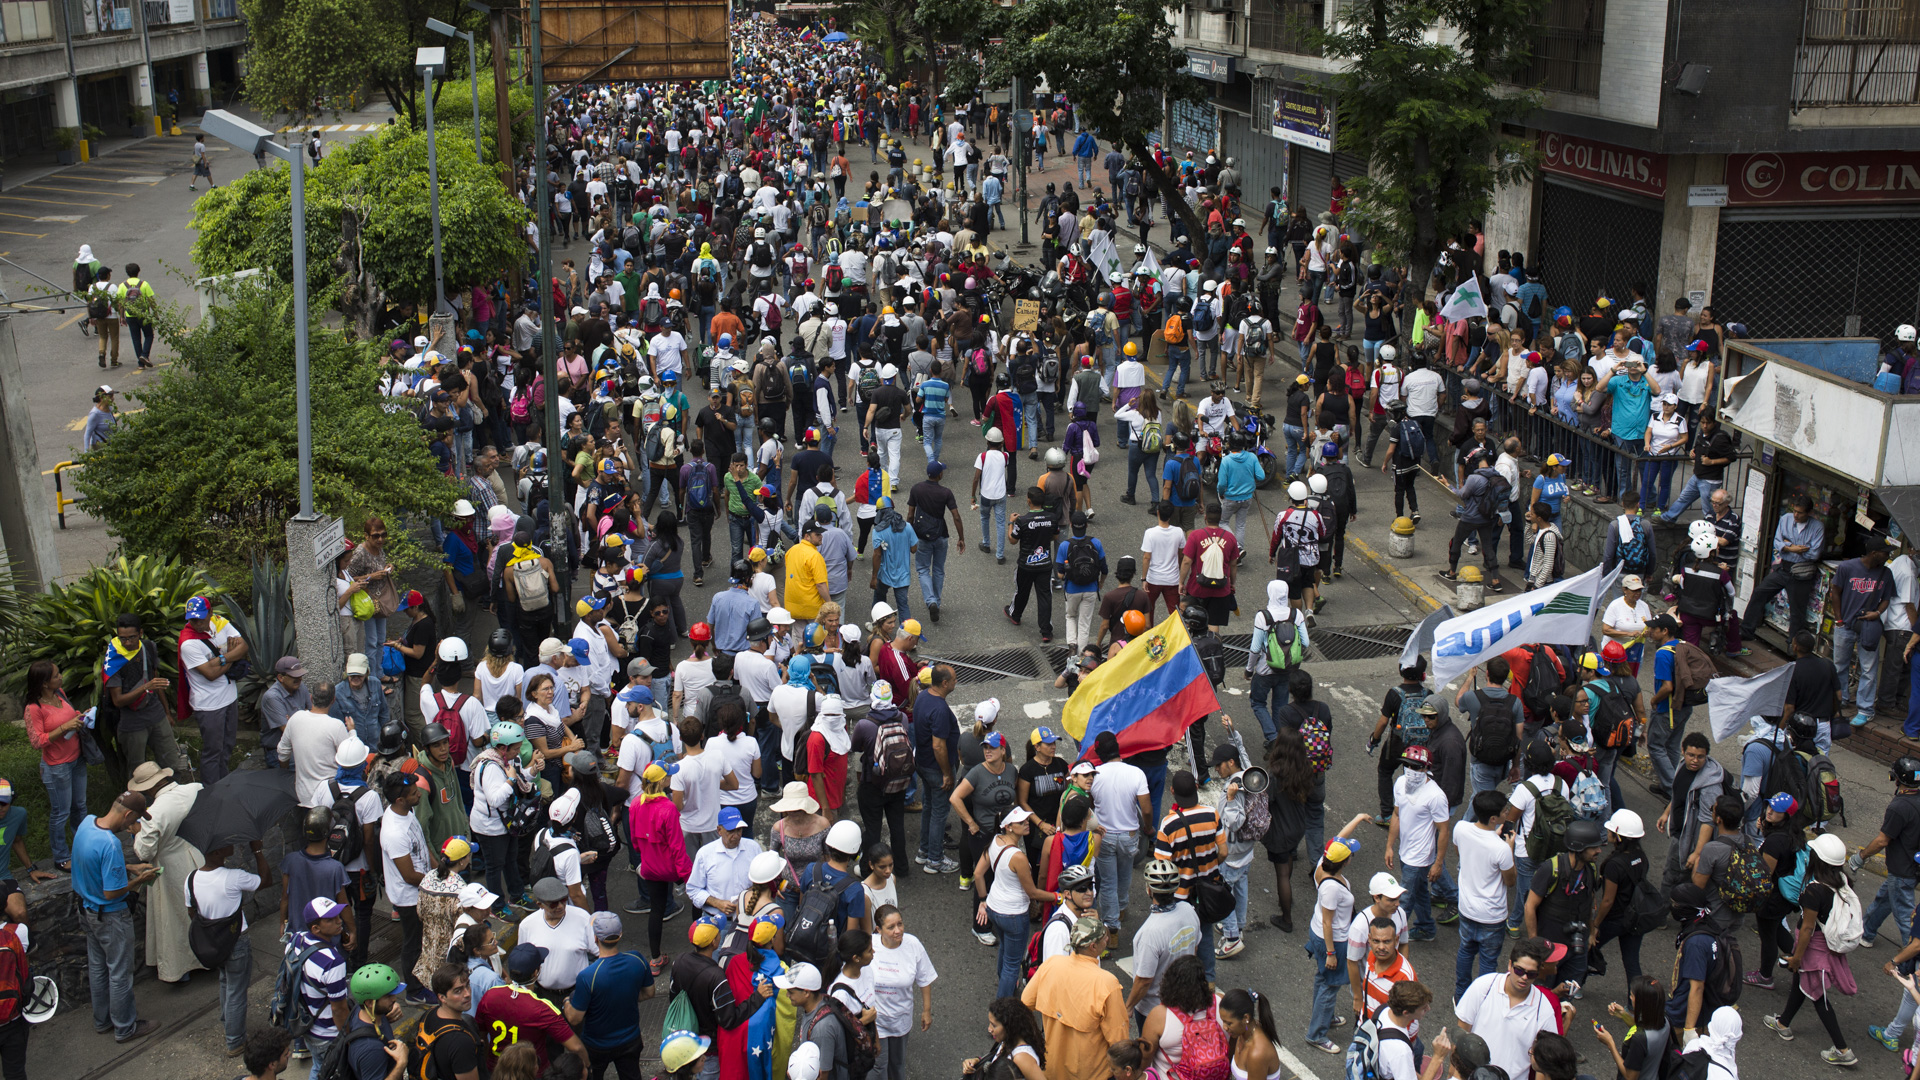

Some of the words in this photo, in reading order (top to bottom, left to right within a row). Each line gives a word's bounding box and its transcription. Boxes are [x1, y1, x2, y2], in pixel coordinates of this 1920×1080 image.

[1285, 101, 1296, 110] CENTRO
[1302, 105, 1317, 115] APUESTAS
[1562, 142, 1651, 183] COLINAS
[1028, 520, 1052, 530] Corona
[321, 534, 333, 548] Avenida
[981, 780, 1015, 797] VENEZUEL
[492, 1020, 518, 1057] 21
